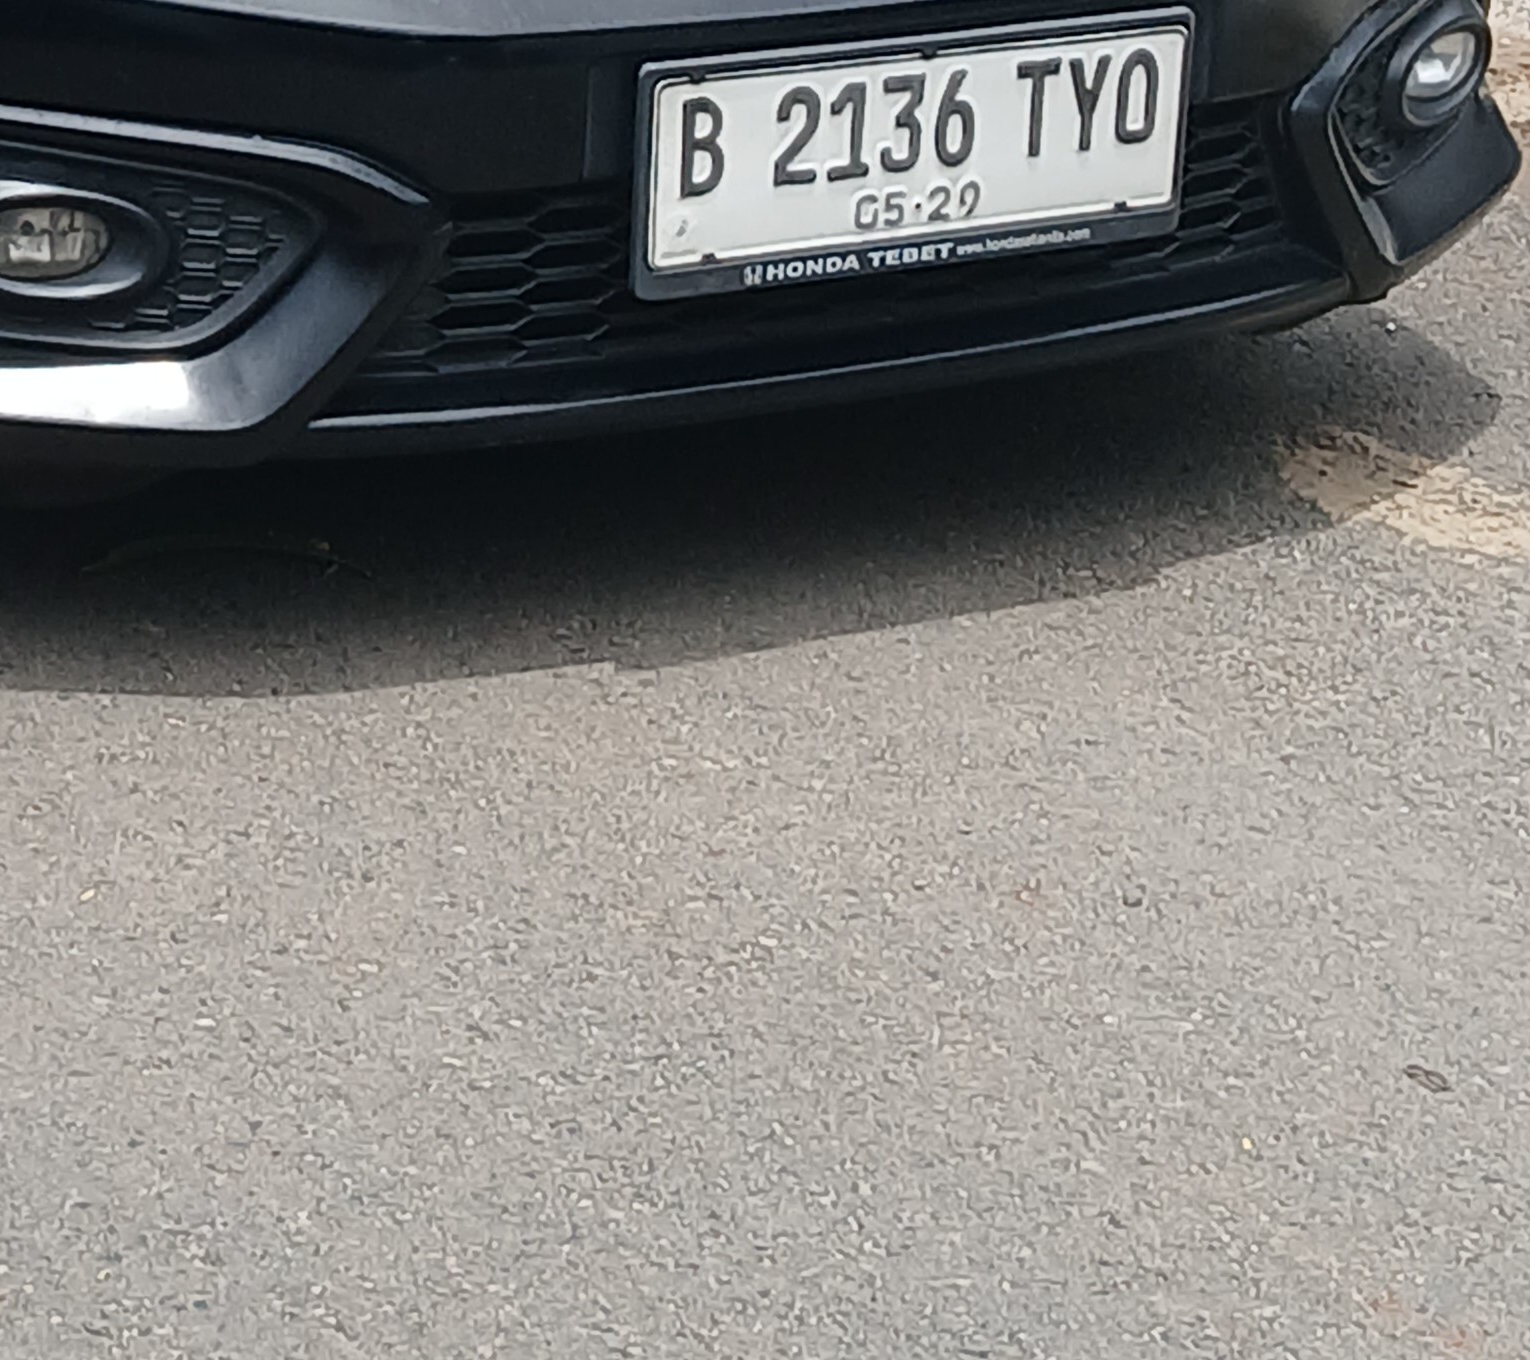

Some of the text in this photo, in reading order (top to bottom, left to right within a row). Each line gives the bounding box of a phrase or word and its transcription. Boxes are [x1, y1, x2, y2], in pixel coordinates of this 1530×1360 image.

[679, 47, 1160, 200] B 2136 TYO
[766, 253, 860, 281] HONDA
[867, 241, 955, 269] TEBET
